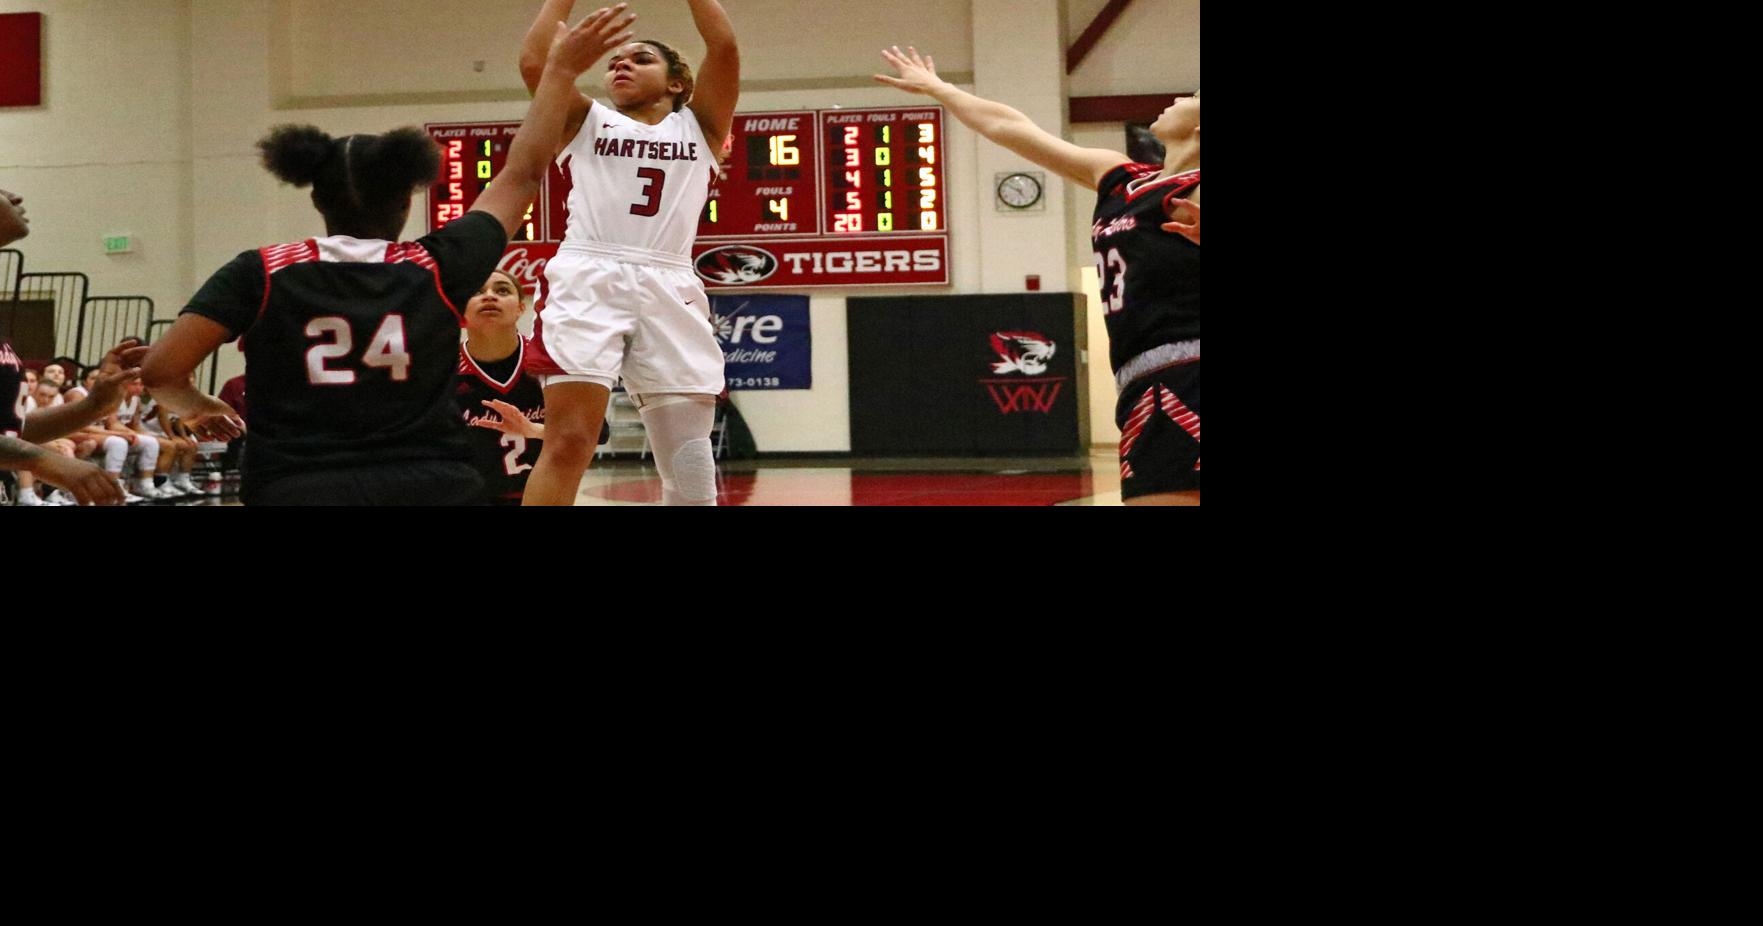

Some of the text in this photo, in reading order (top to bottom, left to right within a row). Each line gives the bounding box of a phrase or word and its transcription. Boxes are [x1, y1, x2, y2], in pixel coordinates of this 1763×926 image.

[745, 117, 800, 132] HOME
[828, 112, 935, 124] PLAYER FOULS POINTS
[433, 129, 466, 138] PLAYER
[470, 128, 498, 136] FOULS
[844, 123, 934, 145] 2 1 3
[448, 139, 491, 159] 2 1
[594, 137, 698, 161] HARTSELLE
[769, 134, 800, 166] 16
[845, 145, 935, 167] 3 0 4
[449, 160, 492, 180] 3 0
[845, 167, 936, 188] 4 1 5
[448, 182, 463, 200] 5
[629, 167, 666, 217] 3
[755, 187, 793, 196] FOULS
[846, 188, 937, 210] 5 1 2
[437, 203, 464, 222] 23
[709, 199, 718, 223] 1
[769, 197, 788, 221] 4
[754, 223, 797, 232] POINTS
[834, 210, 937, 232] 20 0 0
[783, 249, 940, 274] TIGERS
[304, 313, 411, 385] 24
